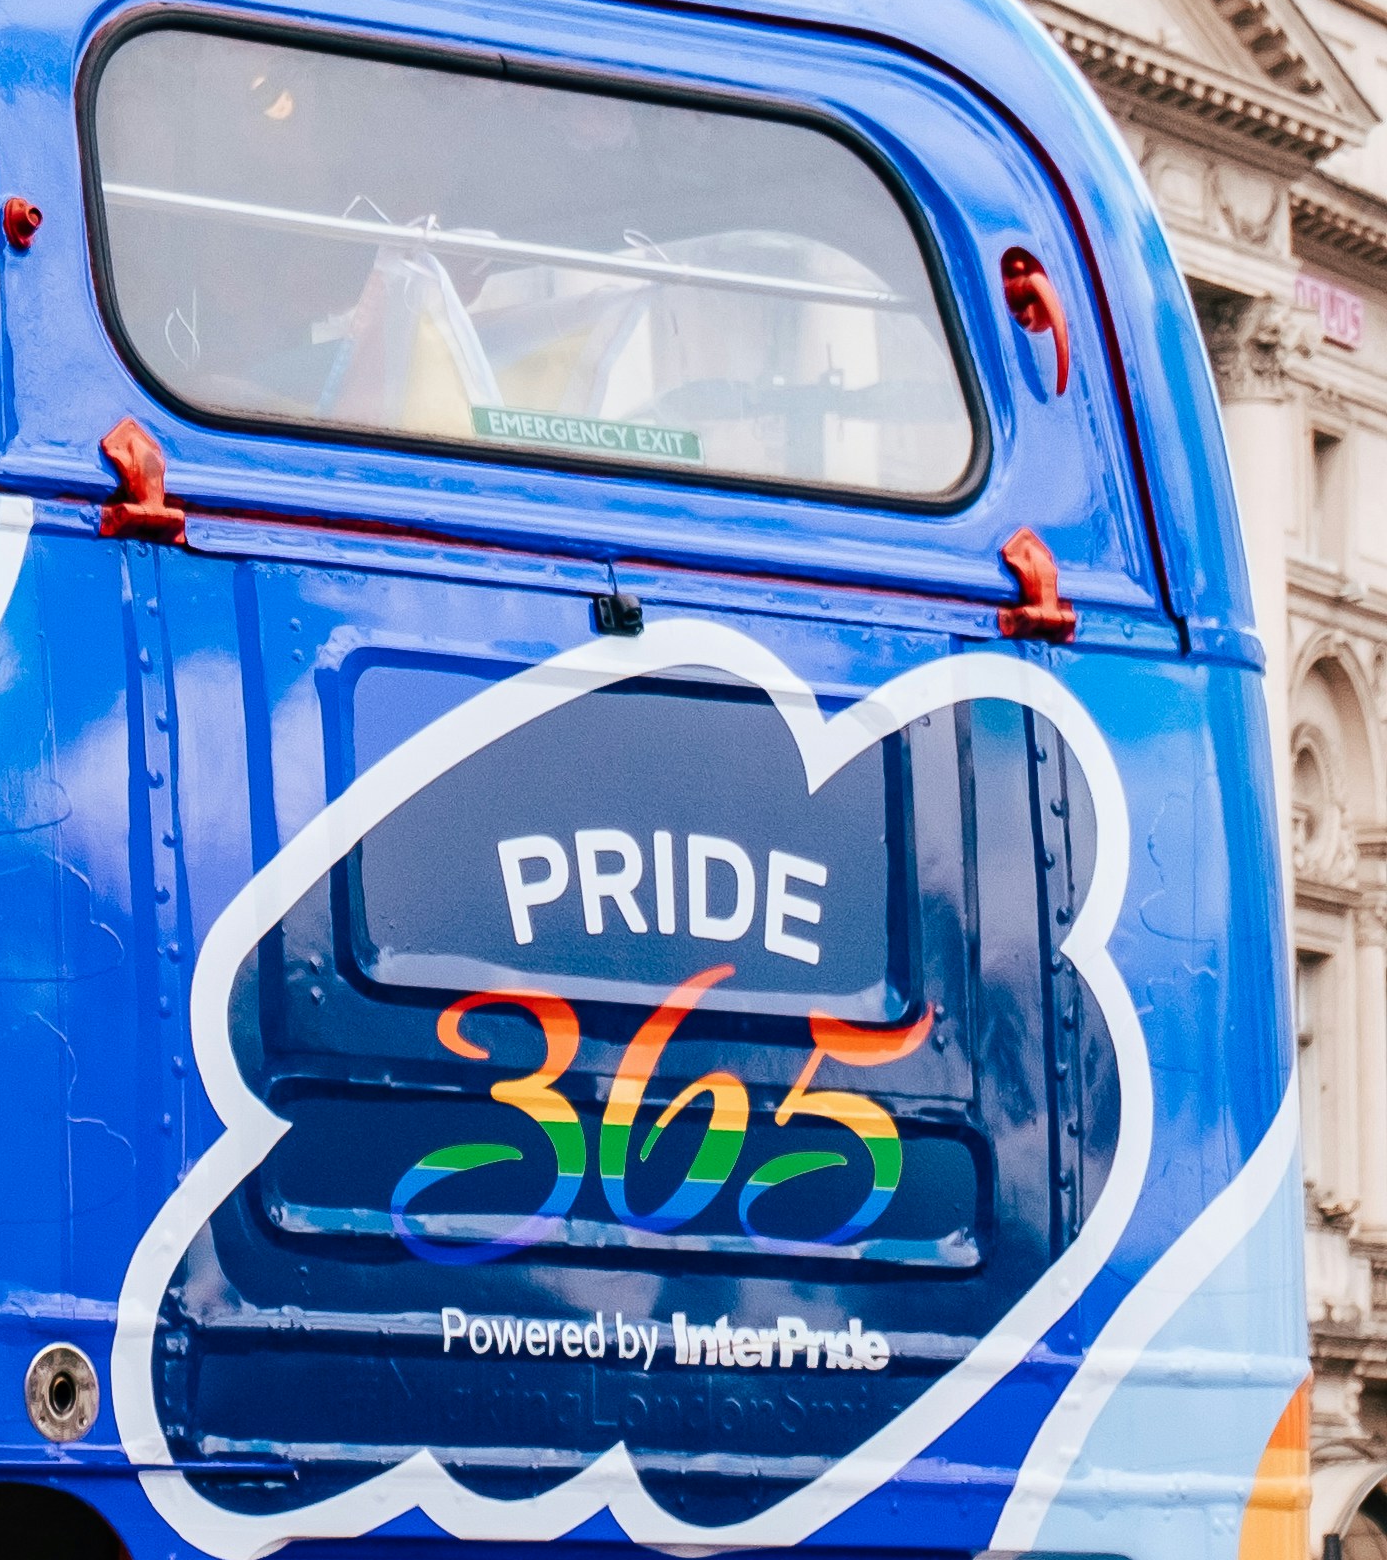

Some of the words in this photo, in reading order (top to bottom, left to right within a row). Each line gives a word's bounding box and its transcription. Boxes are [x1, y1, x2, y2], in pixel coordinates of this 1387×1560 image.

[487, 411, 628, 448] EMERGENCY
[635, 428, 684, 455] EXIT
[497, 828, 827, 965] PRIDE
[390, 963, 935, 1267] 365
[440, 1306, 604, 1359] Powered
[616, 1310, 659, 1371] by
[672, 1311, 891, 1372] InterPride
